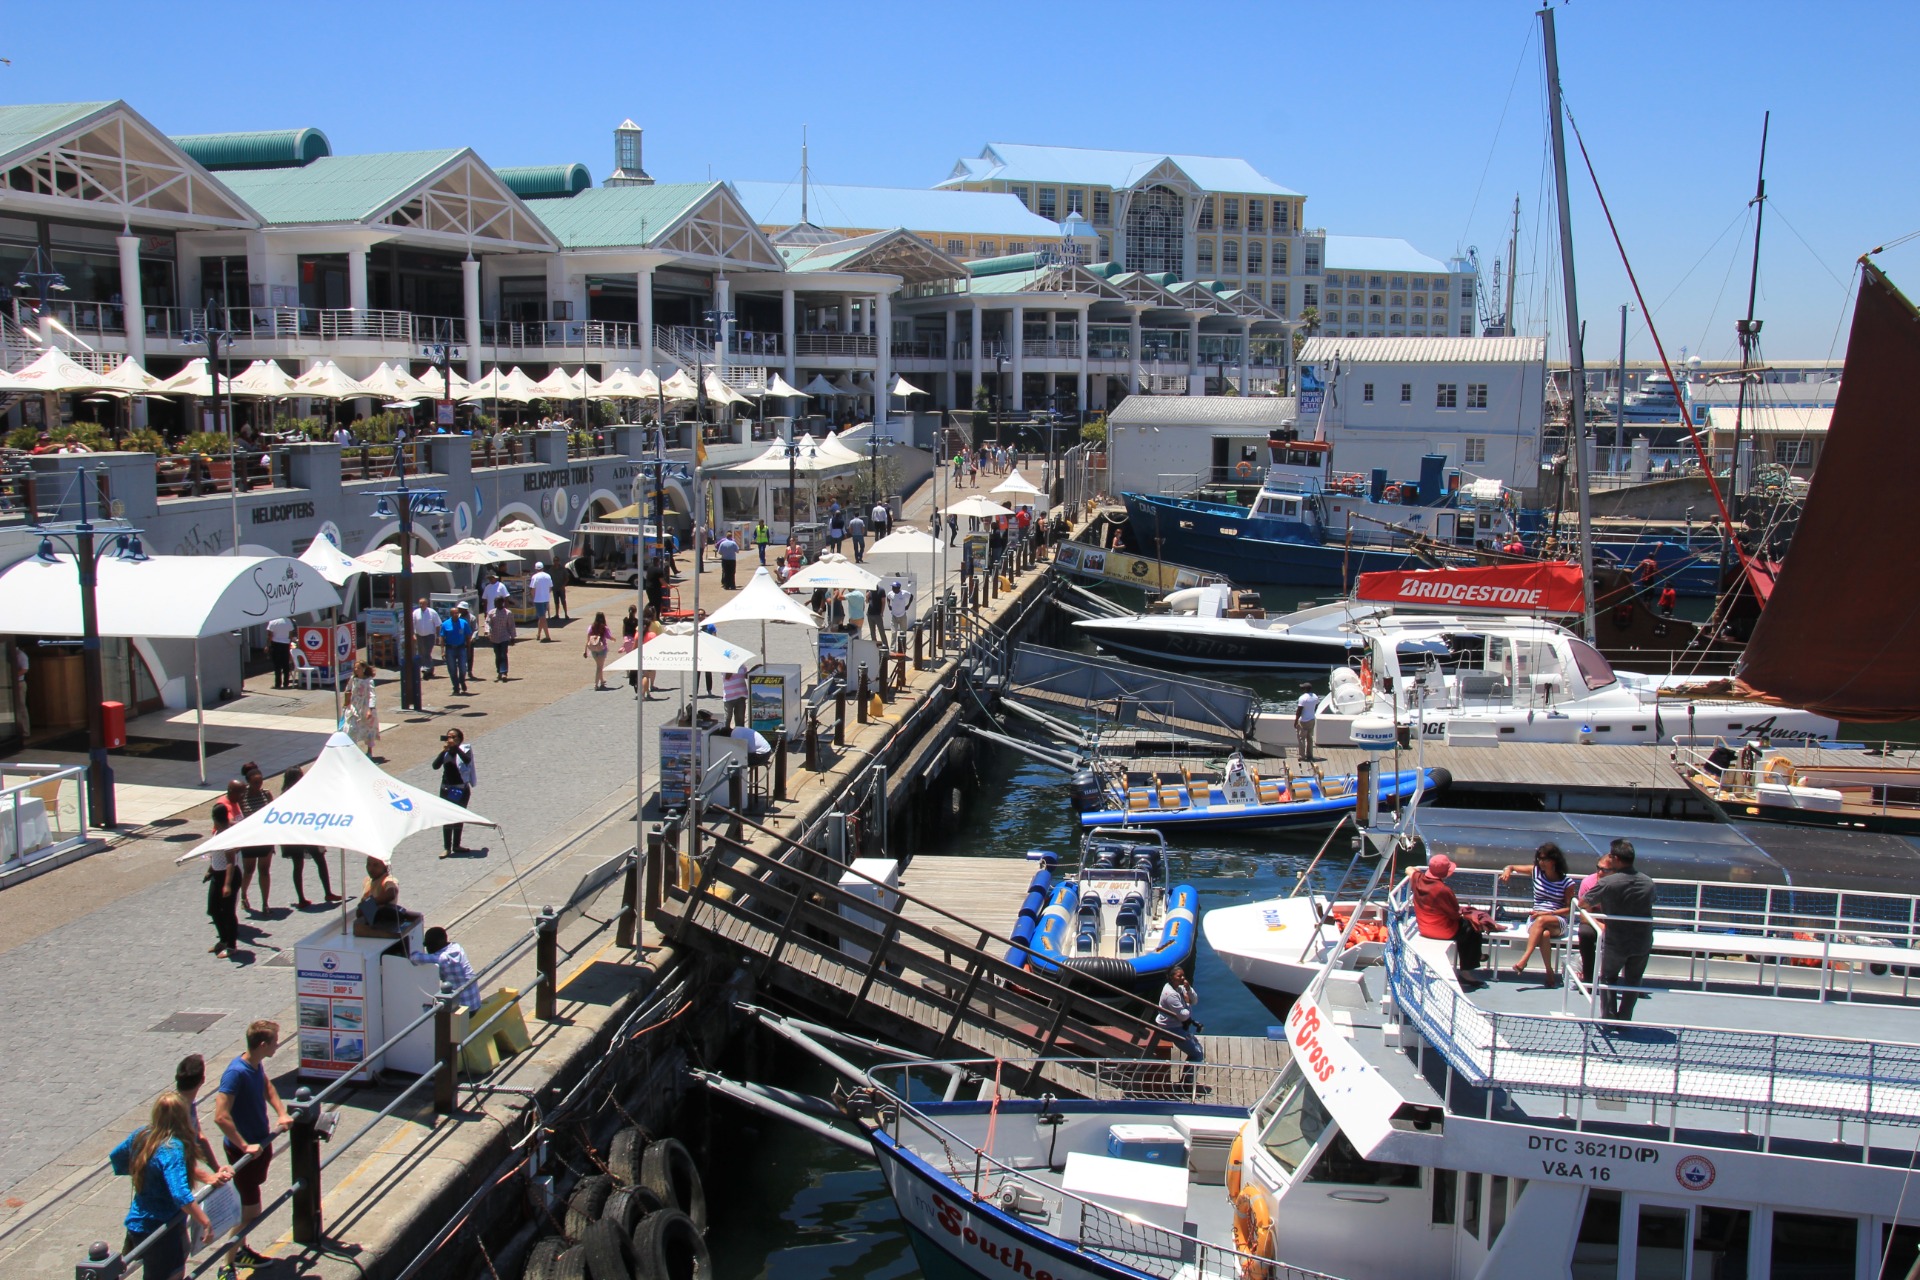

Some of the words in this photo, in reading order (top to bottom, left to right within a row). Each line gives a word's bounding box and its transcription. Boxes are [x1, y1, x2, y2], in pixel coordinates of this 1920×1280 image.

[524, 469, 570, 492] HELICOPTER
[252, 501, 315, 524] HELICOPTERS
[1399, 578, 1543, 604] BRIDGESTONE
[264, 807, 354, 831] bonaqua
[301, 971, 329, 979] SCHEDULED
[1295, 1006, 1335, 1082] Cross
[1528, 1135, 1568, 1152] DTC
[1542, 1160, 1583, 1179] V&A
[1589, 1166, 1611, 1181] 16
[931, 1193, 1064, 1280] Southe
